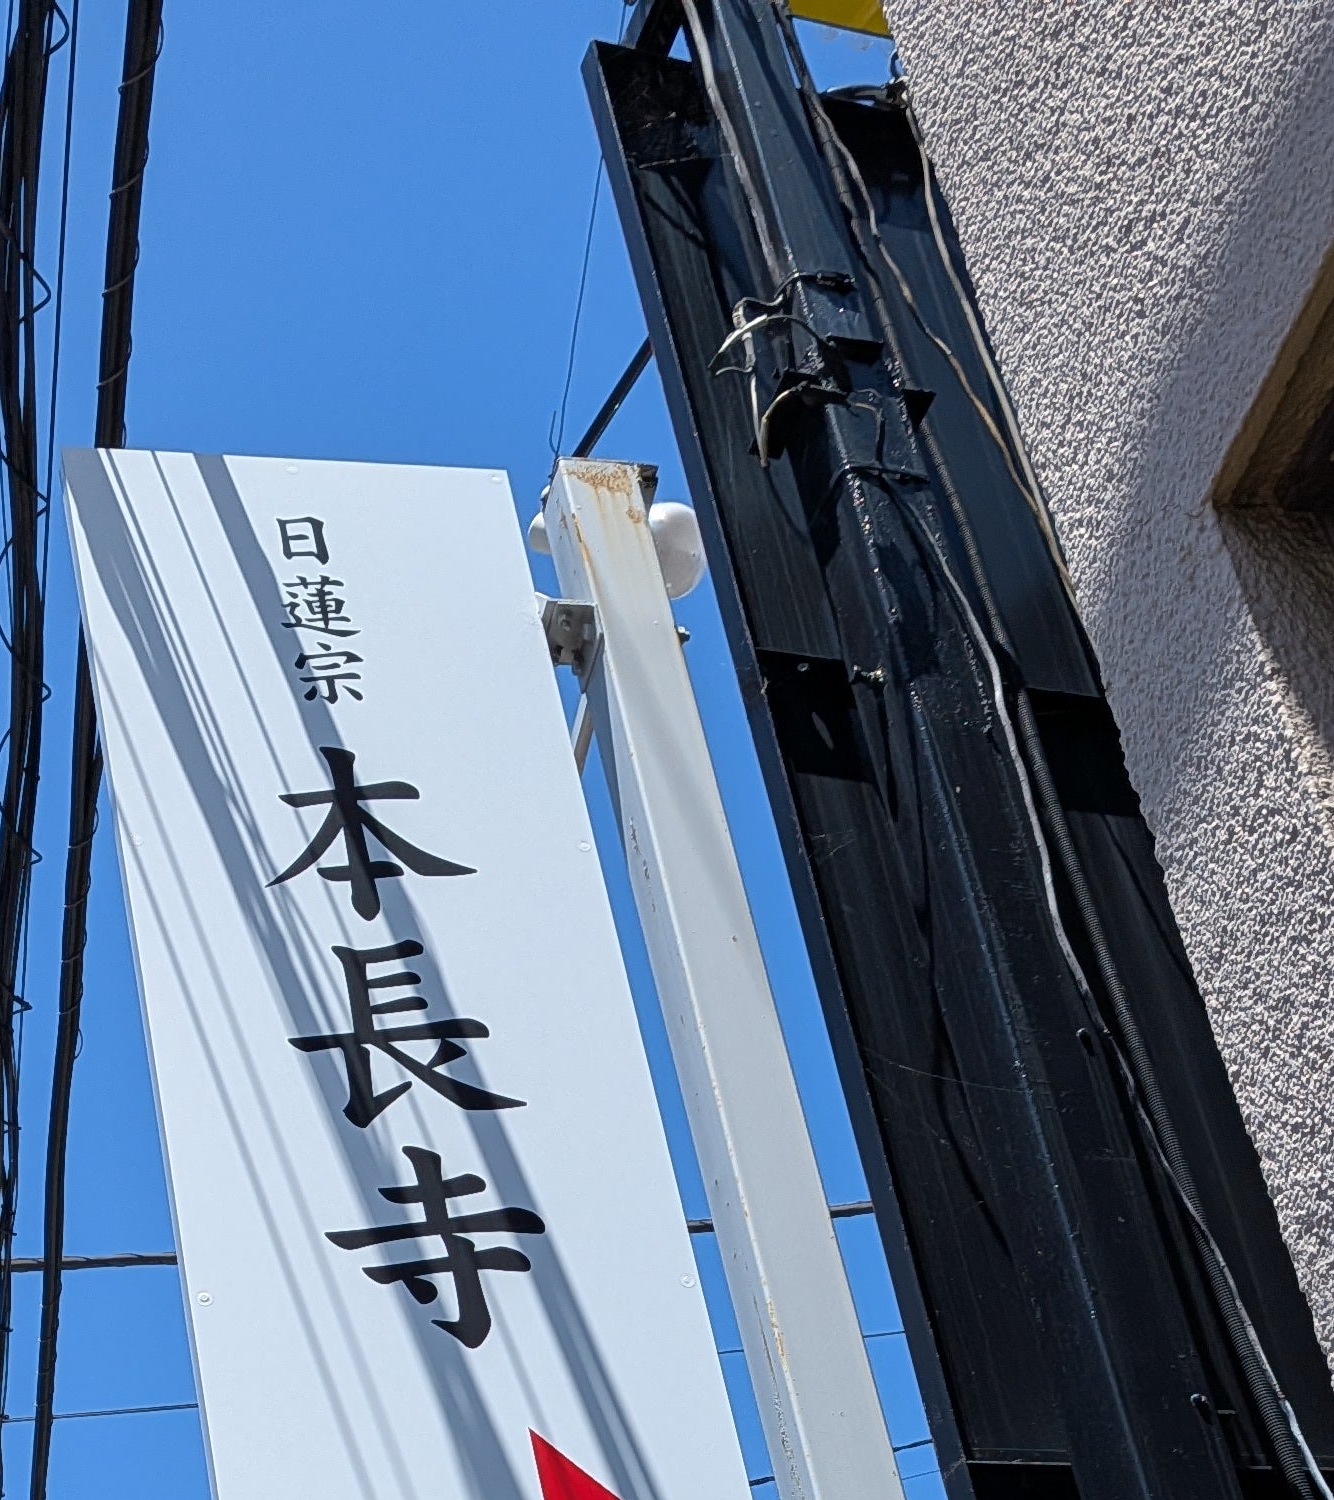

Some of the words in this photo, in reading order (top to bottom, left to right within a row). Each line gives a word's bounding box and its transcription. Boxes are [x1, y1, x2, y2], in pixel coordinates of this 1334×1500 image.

[275, 515, 365, 706] 日蓮宗
[266, 746, 547, 1350] 本長寺
